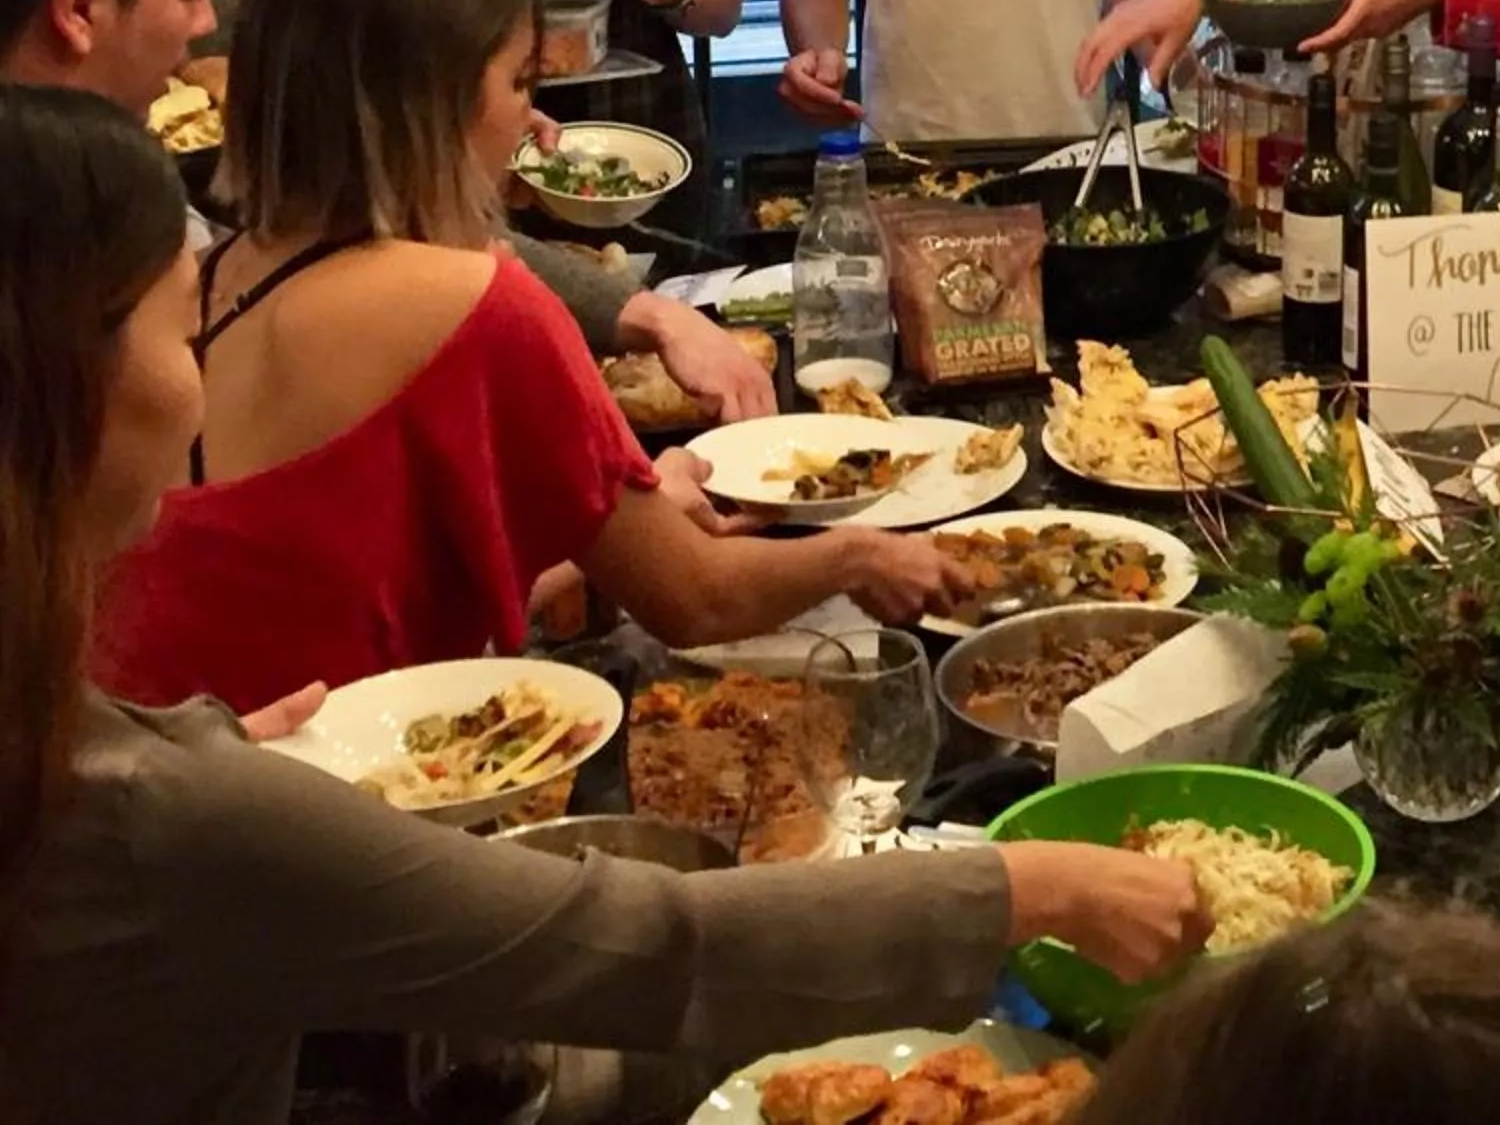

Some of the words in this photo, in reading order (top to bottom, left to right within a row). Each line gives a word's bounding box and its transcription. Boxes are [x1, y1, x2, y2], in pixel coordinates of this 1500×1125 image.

[934, 333, 1031, 361] GRATED
[1406, 314, 1435, 357] @
[1453, 309, 1496, 354] THE
